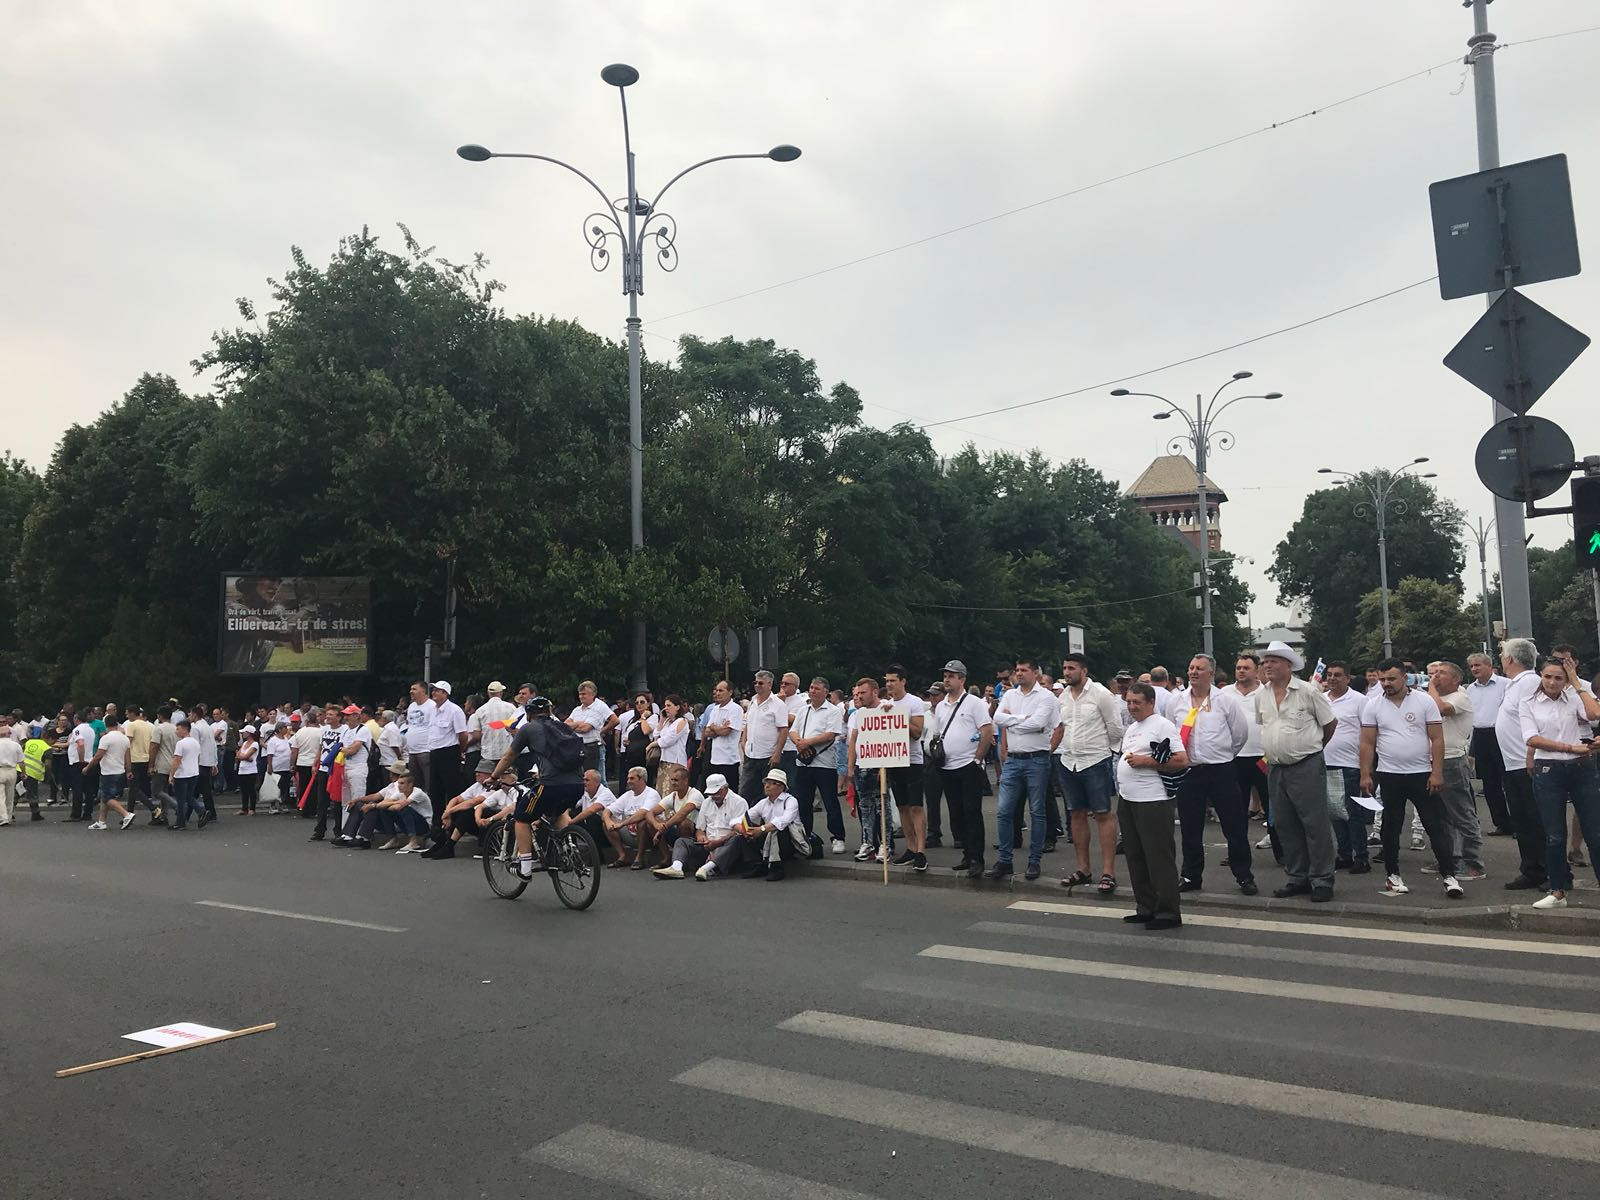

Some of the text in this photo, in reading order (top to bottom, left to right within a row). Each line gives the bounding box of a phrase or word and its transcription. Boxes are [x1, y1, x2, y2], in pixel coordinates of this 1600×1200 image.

[227, 616, 367, 630] Eliberează-te de stres!
